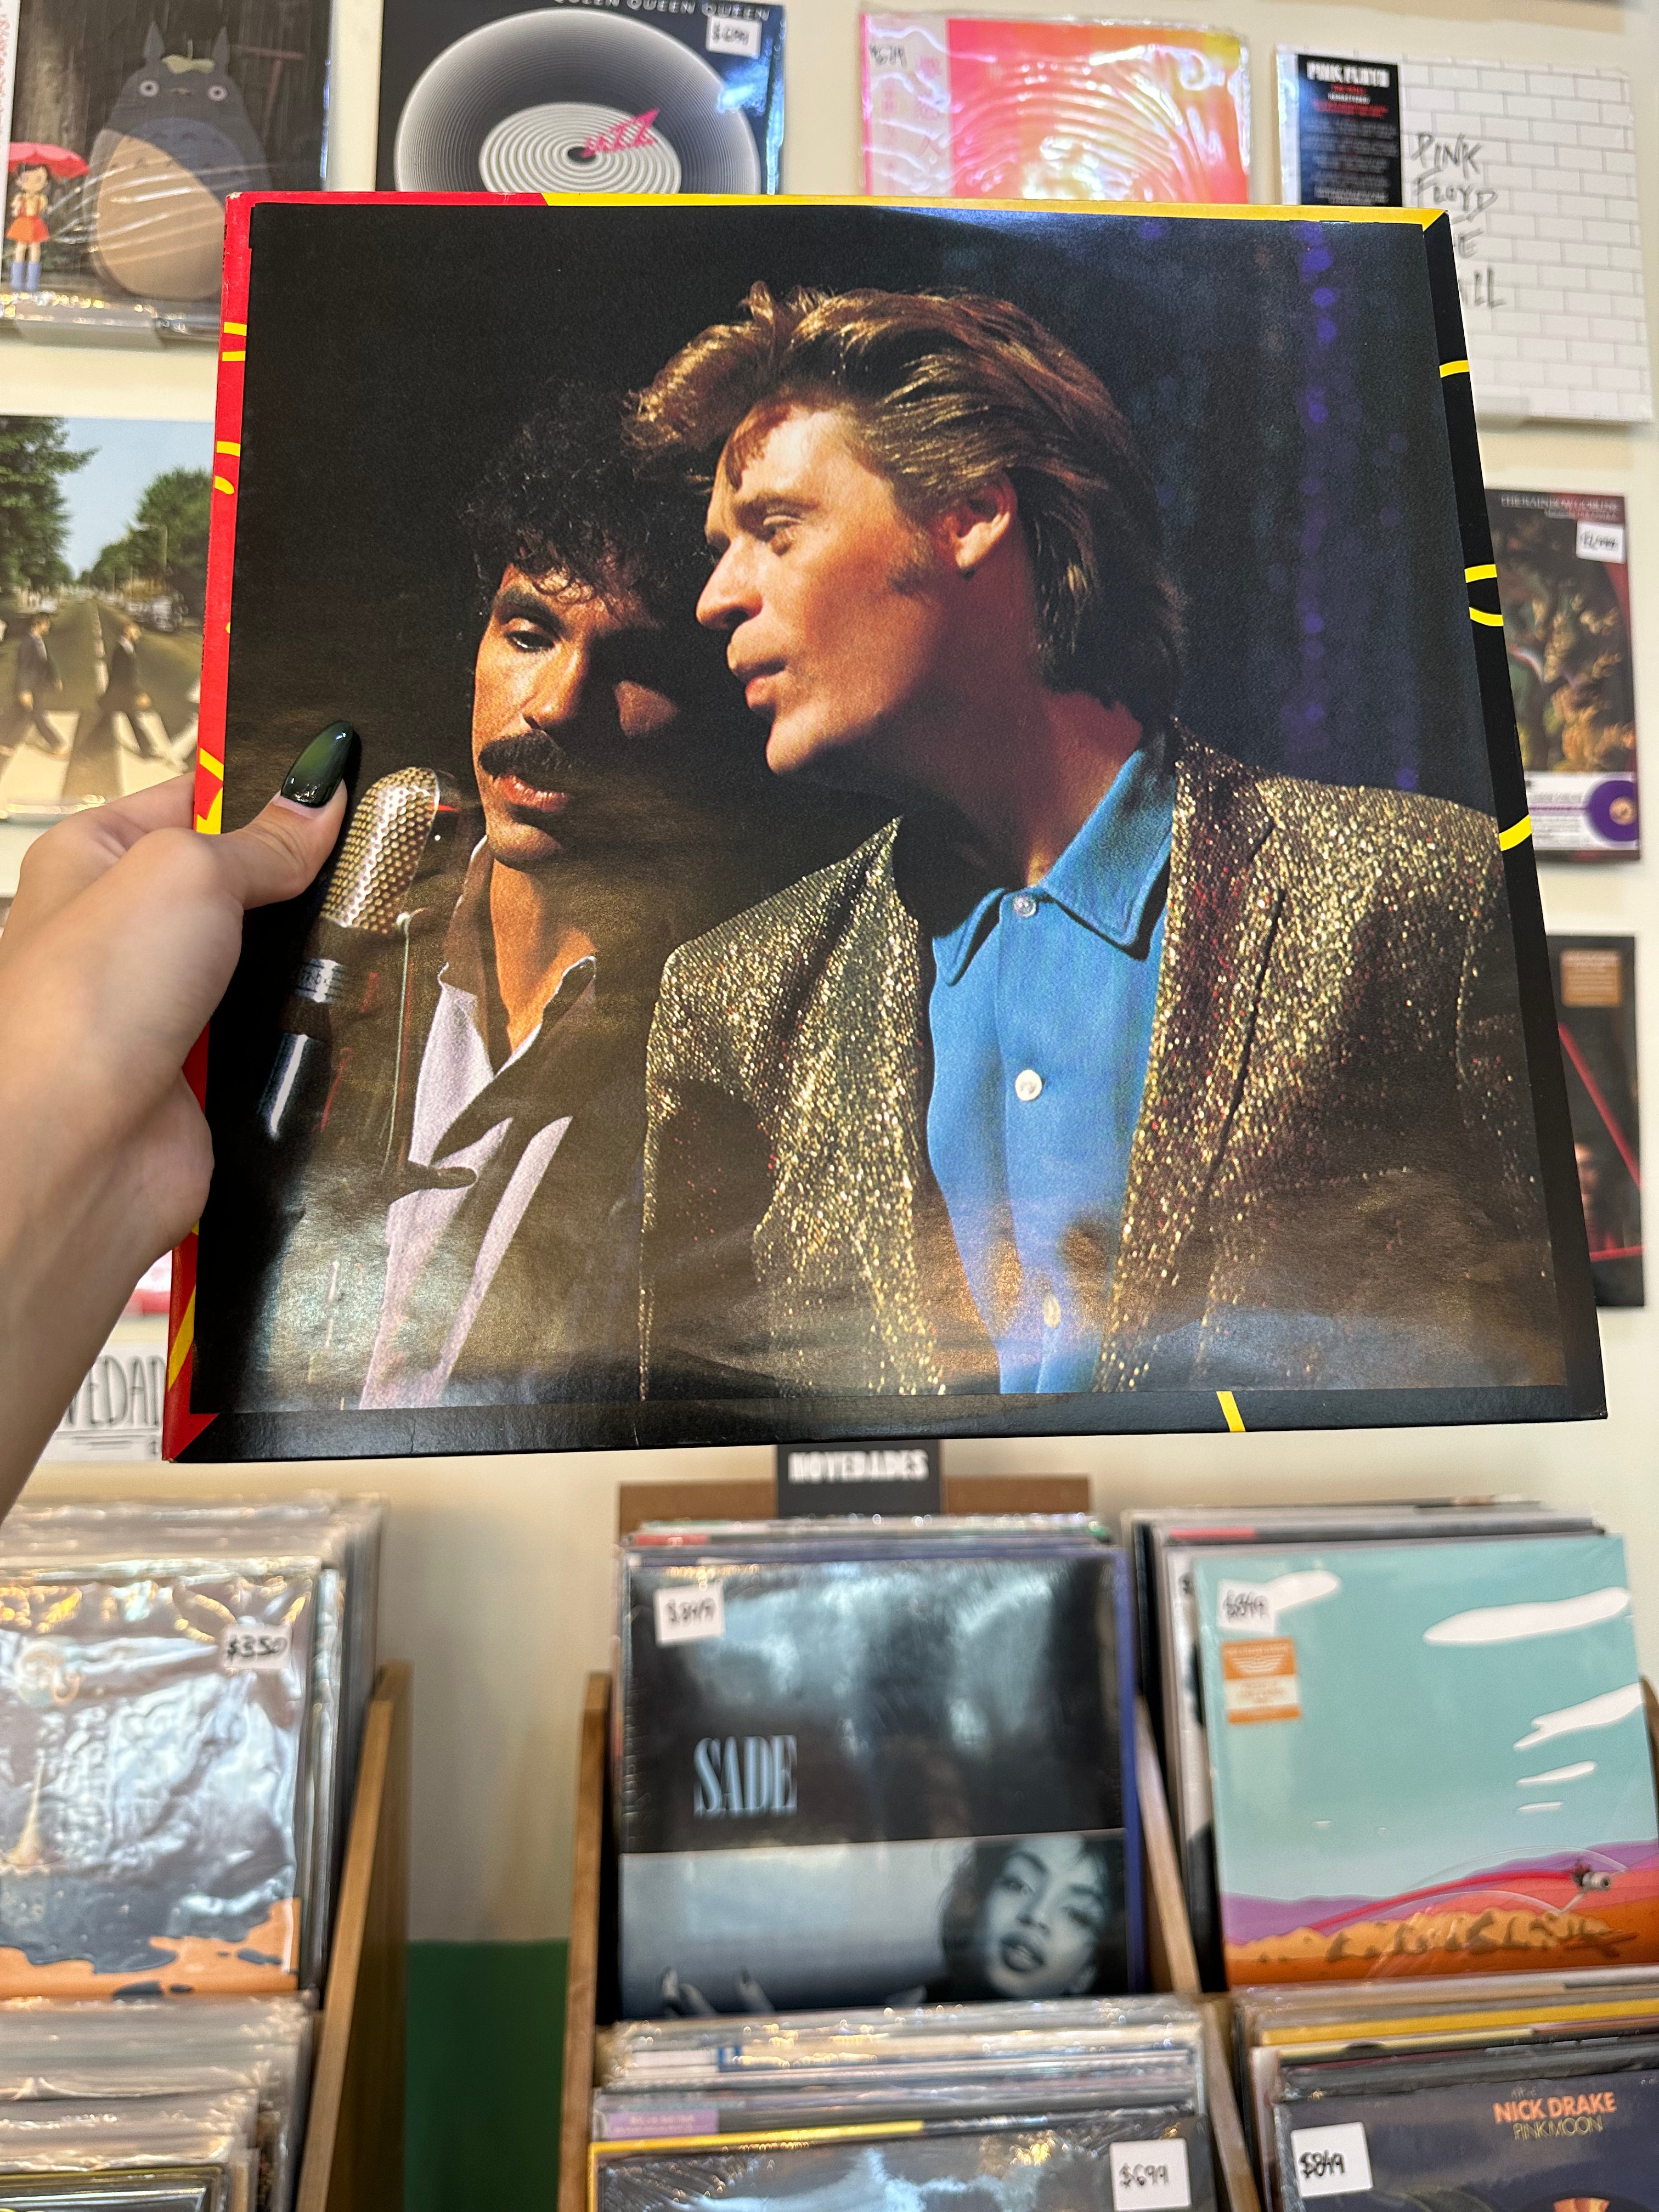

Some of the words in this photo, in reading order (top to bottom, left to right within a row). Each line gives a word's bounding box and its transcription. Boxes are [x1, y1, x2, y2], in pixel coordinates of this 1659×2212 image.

[627, 0, 696, 14] QUEEN
[702, 2, 770, 21] QUEEN
[1411, 133, 1481, 180] PINK
[1414, 166, 1498, 222] FLOYD
[788, 1449, 929, 1484] NOVEDADES
[227, 1634, 288, 1661] $350
[693, 1735, 798, 1819] SADE
[1493, 2098, 1547, 2124] NICK
[1547, 2091, 1617, 2119] DRAKE
[1513, 2120, 1549, 2141] PINK
[1549, 2115, 1604, 2137] MOON
[1119, 2163, 1170, 2188] $699
[1299, 2149, 1346, 2179] $849
